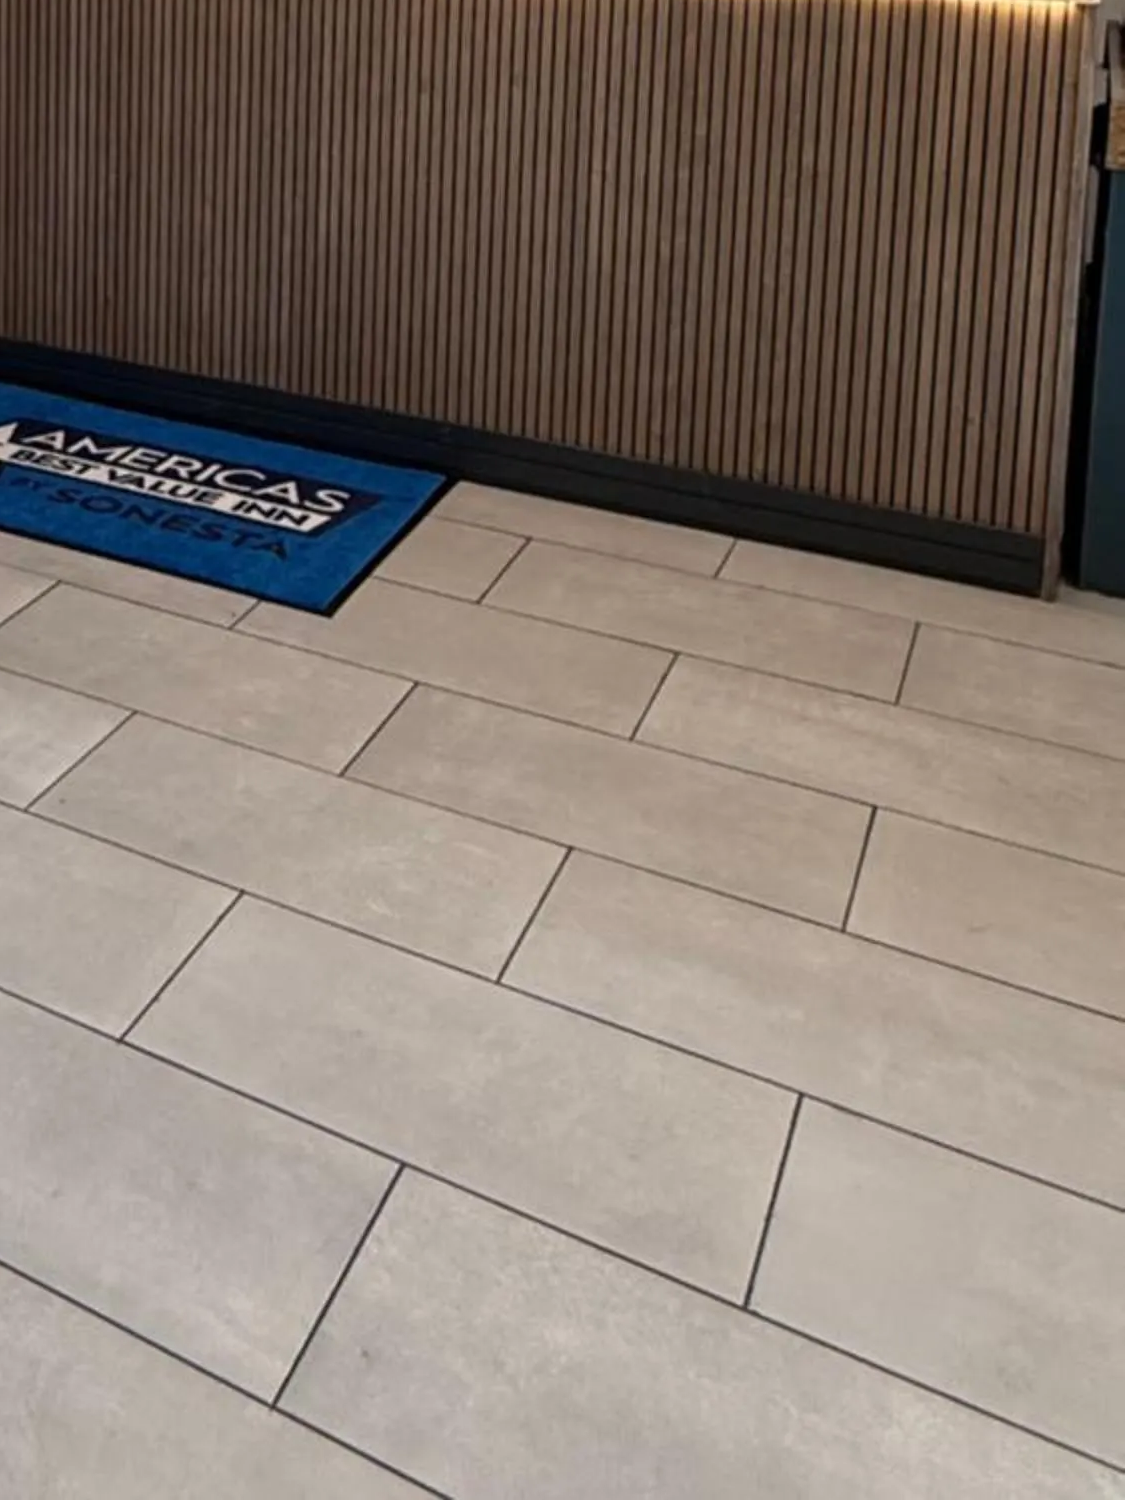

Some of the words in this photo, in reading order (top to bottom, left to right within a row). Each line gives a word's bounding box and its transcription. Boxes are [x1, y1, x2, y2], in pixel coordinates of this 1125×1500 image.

[9, 449, 100, 476] BEST
[107, 468, 222, 504] VALUE
[231, 500, 310, 526] INN
[20, 429, 352, 513] AMERICAS
[47, 488, 288, 562] SONESTA
